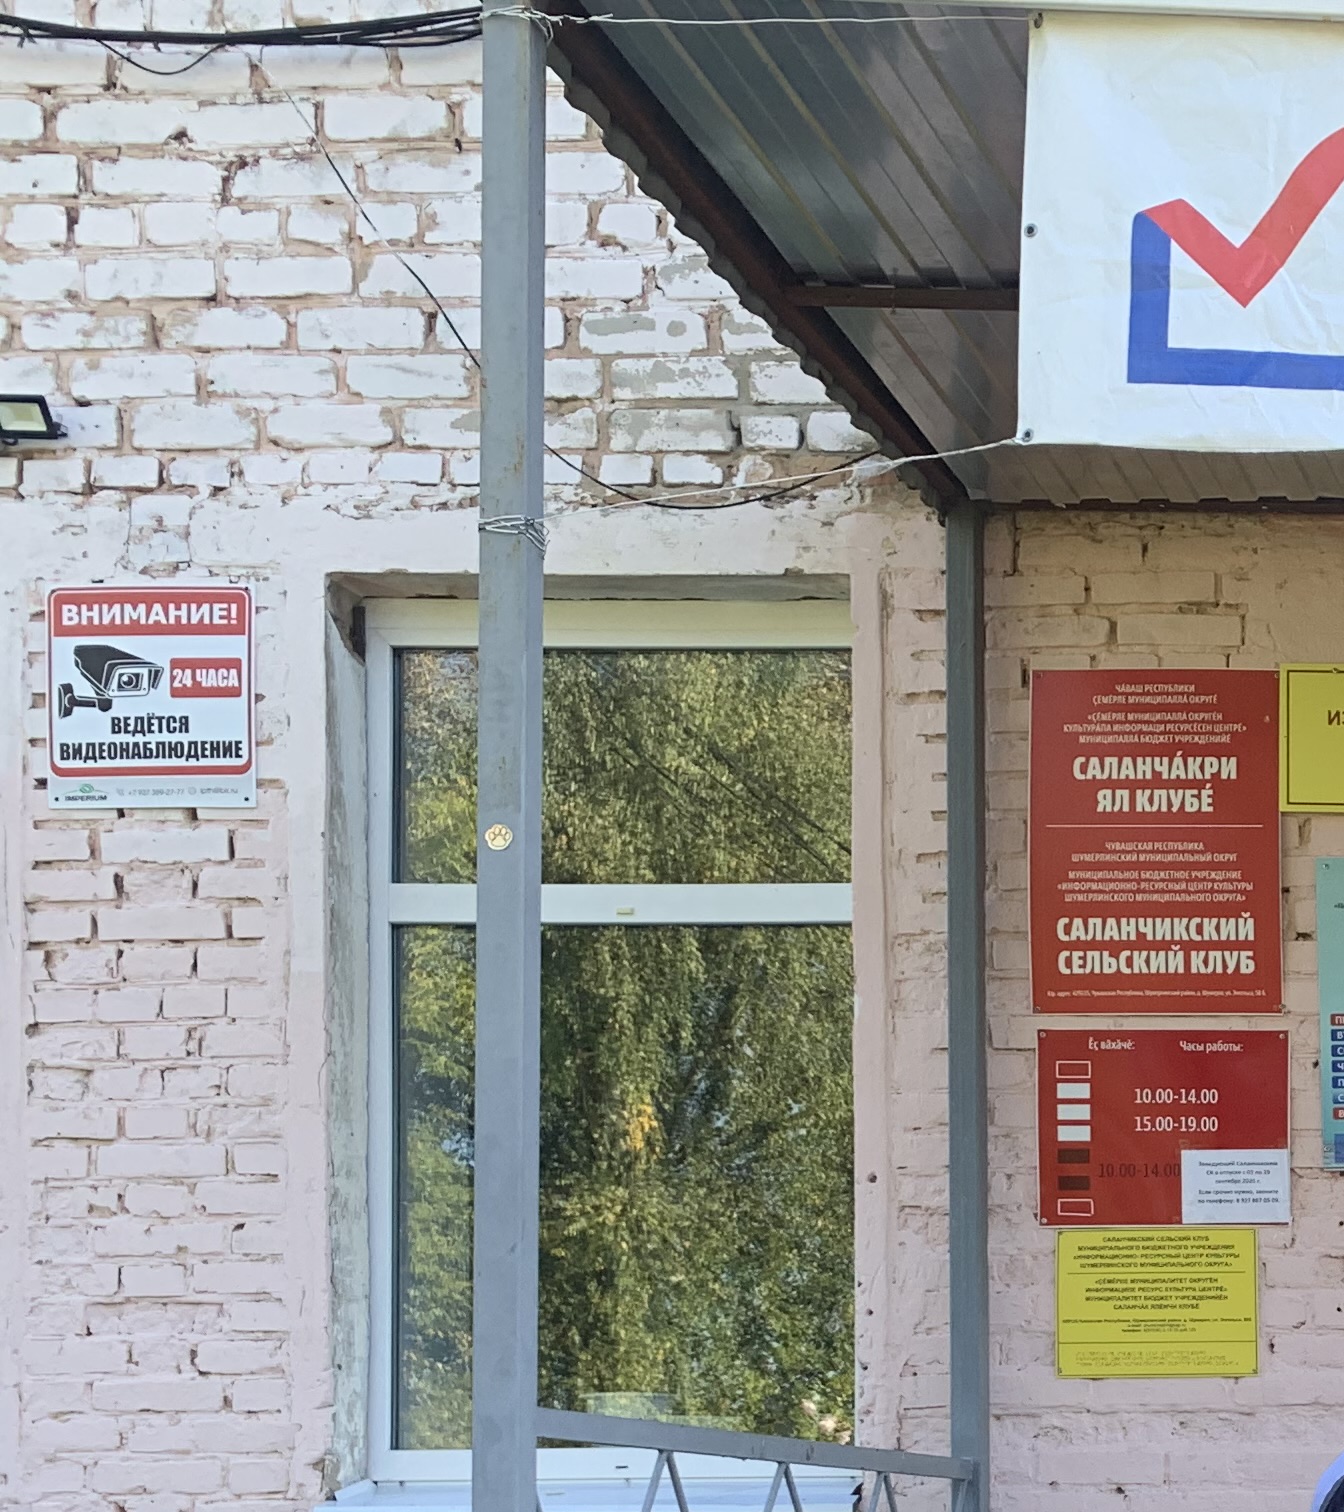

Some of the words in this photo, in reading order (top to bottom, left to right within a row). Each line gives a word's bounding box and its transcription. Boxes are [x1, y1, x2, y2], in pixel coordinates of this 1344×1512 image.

[61, 603, 238, 626] ВНИМАНИЕ!
[173, 668, 192, 687] 24
[196, 668, 239, 688] ЧАСА
[1144, 683, 1195, 693] РЕСПУБЛИКИ
[111, 713, 189, 736] ВЕДЁТСЯ
[1140, 734, 1174, 744] БЮДЖЕТ
[59, 740, 243, 763] ВИДЕОНАБЛЮДЕНИЕ
[1096, 789, 1130, 812] ЯЛ
[1105, 841, 1153, 851] ЧУВАШСКАЯ
[1153, 841, 1205, 851] РЕСПУБЛИКА
[1071, 852, 1138, 862] ШУМЕРЛИНСКИЙ
[1138, 852, 1213, 862] МУНИЦИПАЛЬНЫЙ
[1213, 853, 1238, 862] ОКРУГ
[1068, 870, 1140, 880] МУНИЦИПАЛЬНОЕ
[1140, 870, 1190, 880] БЮДЖЕТНОЕ
[1191, 870, 1242, 880] УЧРЕЖДЕНИЕ
[1187, 881, 1213, 891] ЦЕНТР
[1213, 881, 1254, 891] КУЛЬТУРЫ
[1064, 893, 1135, 902] ШУМЕРЛИНСКОГО
[1135, 893, 1212, 903] МУНИЦИПАЛЬНОГО
[1056, 911, 1255, 942] САЛАНЧИКСКИЙ
[1057, 944, 1185, 975] СЕЛЬСКИЙ
[1191, 950, 1256, 975] КЛУБ
[1179, 1040, 1205, 1052] Часы
[1206, 1040, 1244, 1053] работы:
[1134, 1088, 1219, 1104] 10.00-14.00
[1134, 1116, 1219, 1132] 15.00-19.00
[1099, 1163, 1181, 1178] 10.00-14.00
